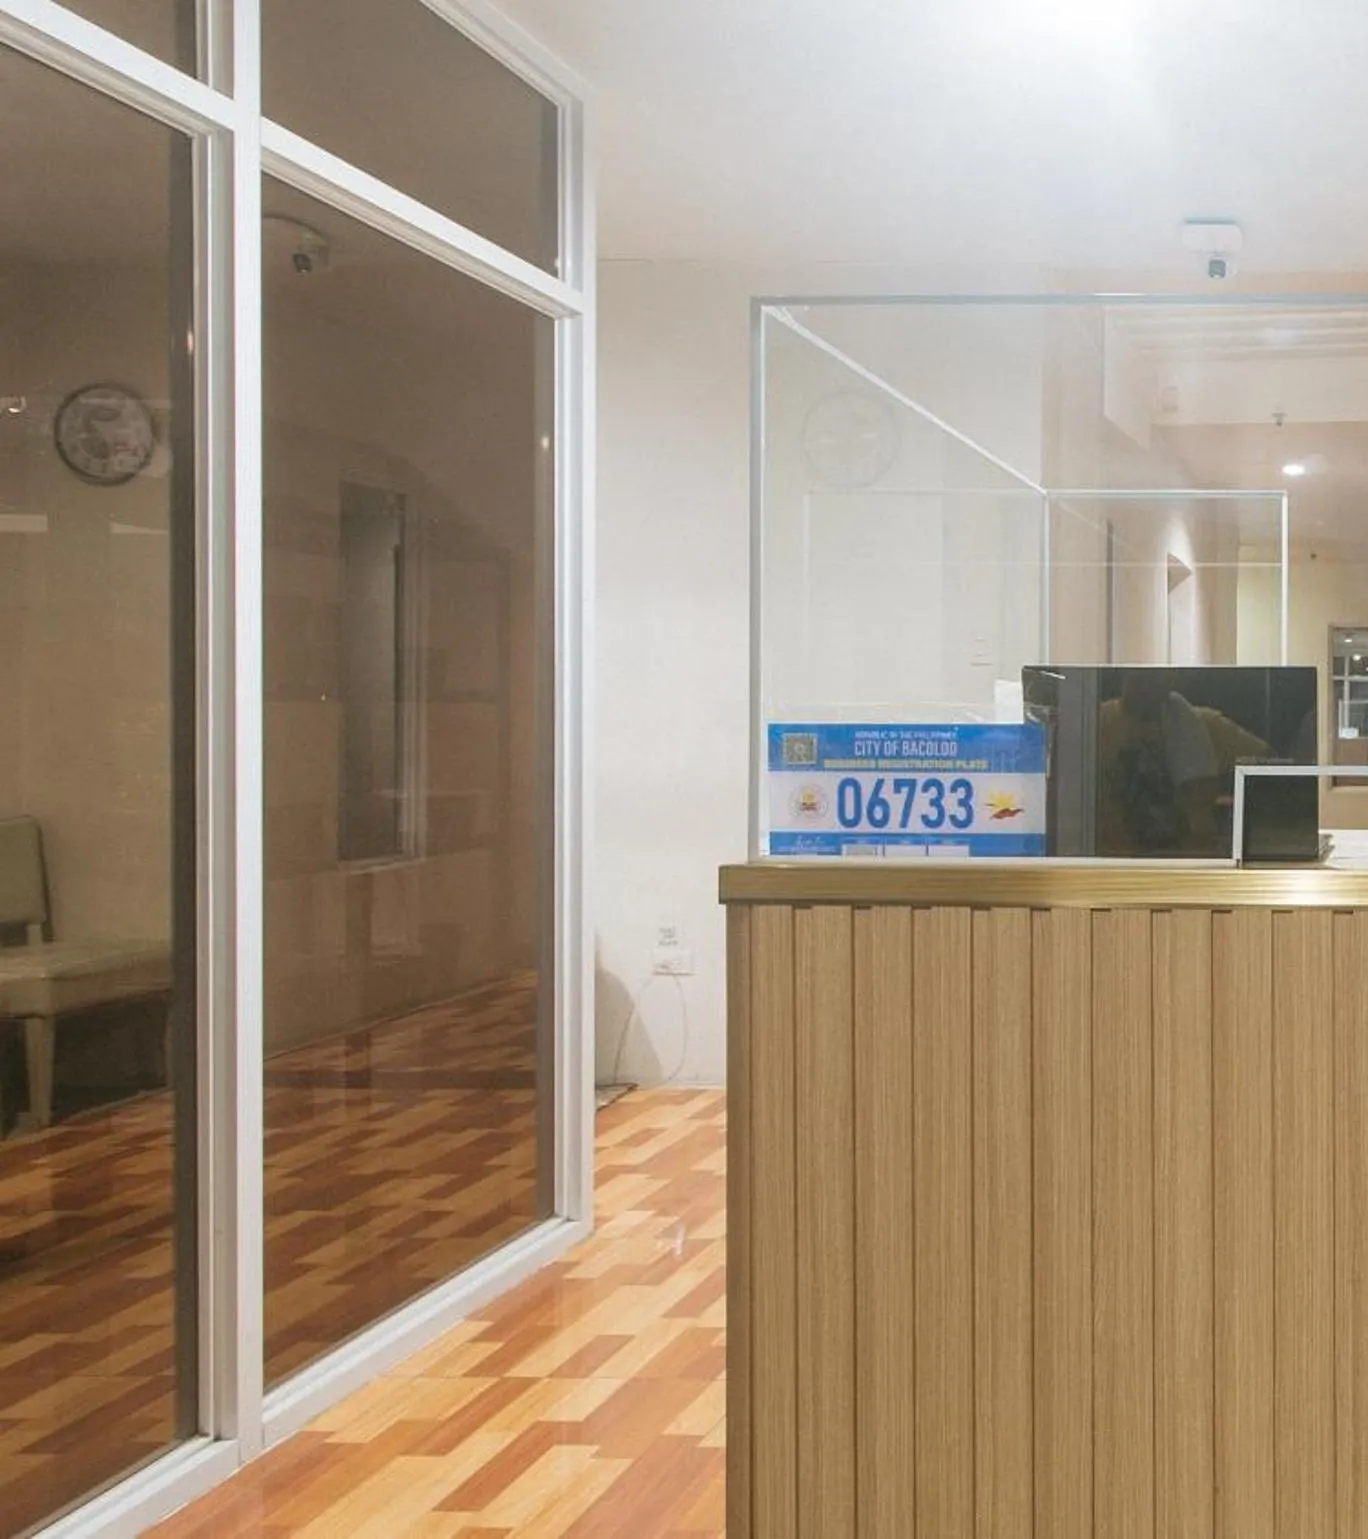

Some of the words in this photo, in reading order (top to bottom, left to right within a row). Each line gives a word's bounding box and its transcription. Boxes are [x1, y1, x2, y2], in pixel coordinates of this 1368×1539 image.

[854, 740, 880, 757] CITY
[883, 740, 900, 757] OF
[901, 740, 958, 757] BACOLOD
[836, 777, 975, 830] 06733
